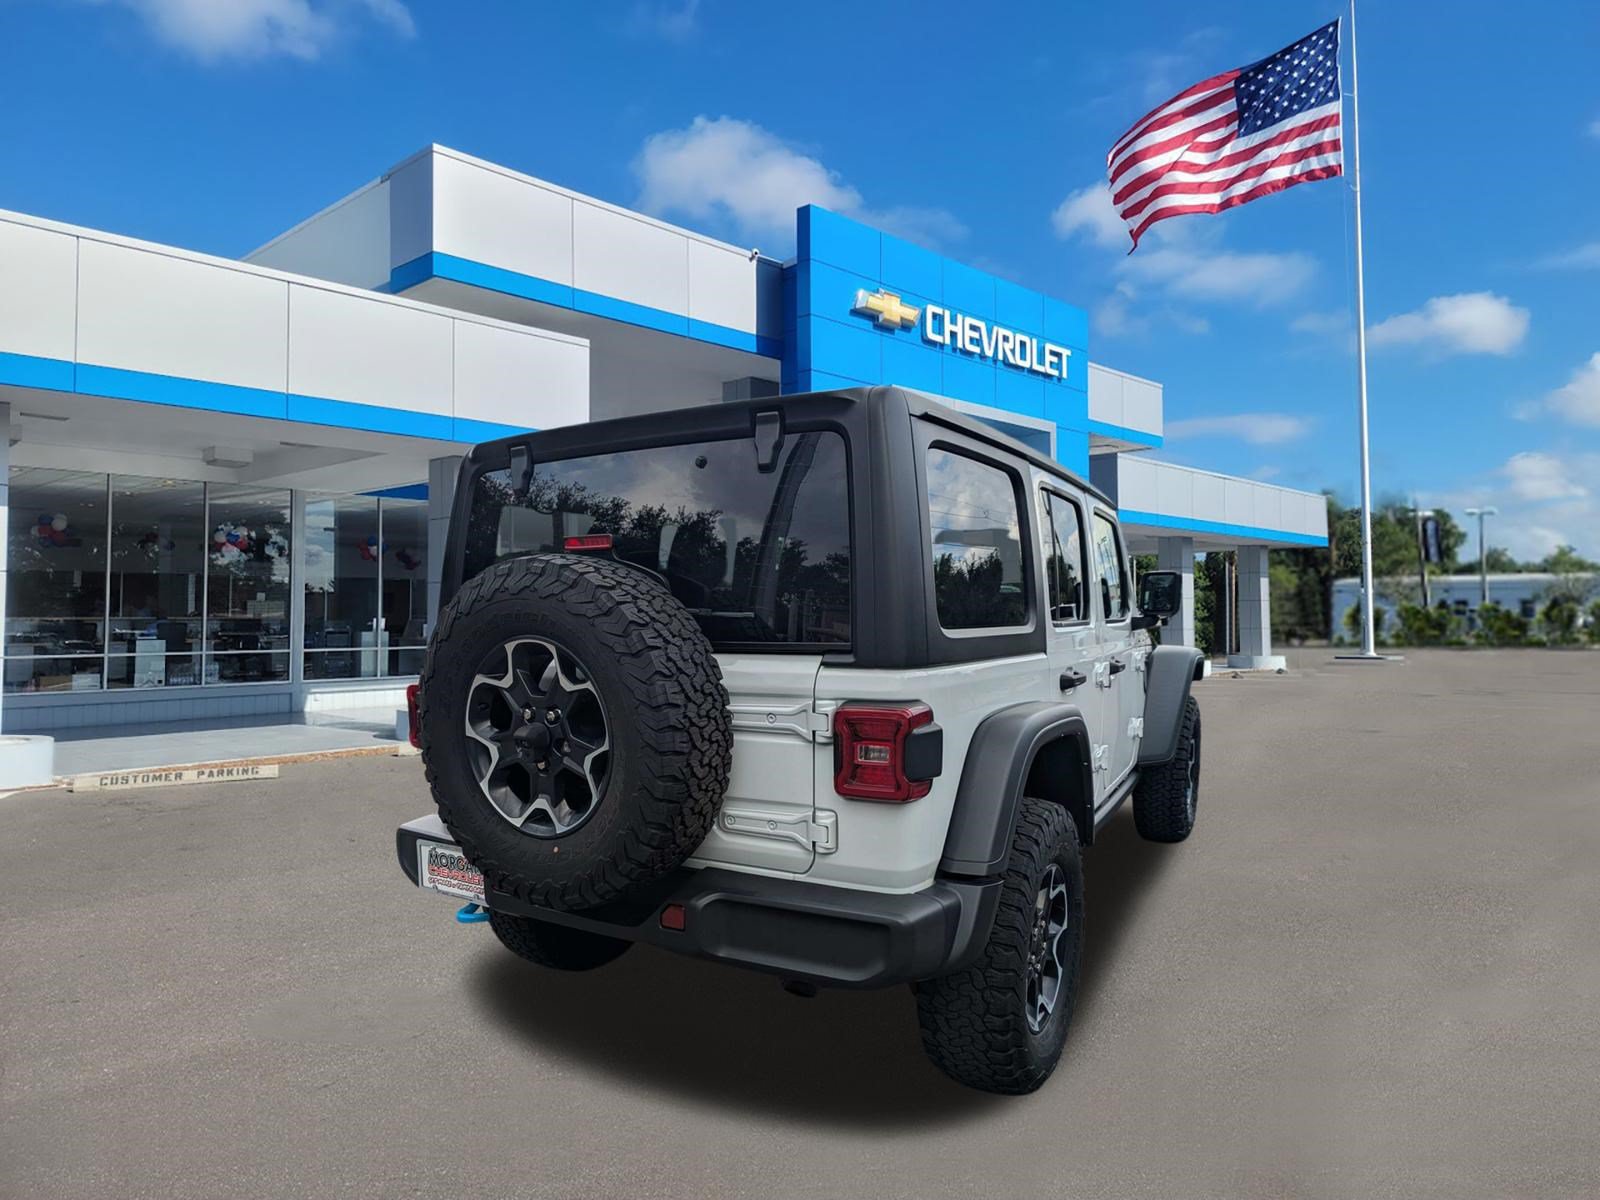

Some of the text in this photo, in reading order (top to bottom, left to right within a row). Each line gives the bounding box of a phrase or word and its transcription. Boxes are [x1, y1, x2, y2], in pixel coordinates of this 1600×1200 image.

[924, 304, 1072, 379] CHEVROLET
[100, 767, 260, 786] CUSTOMER PARKING
